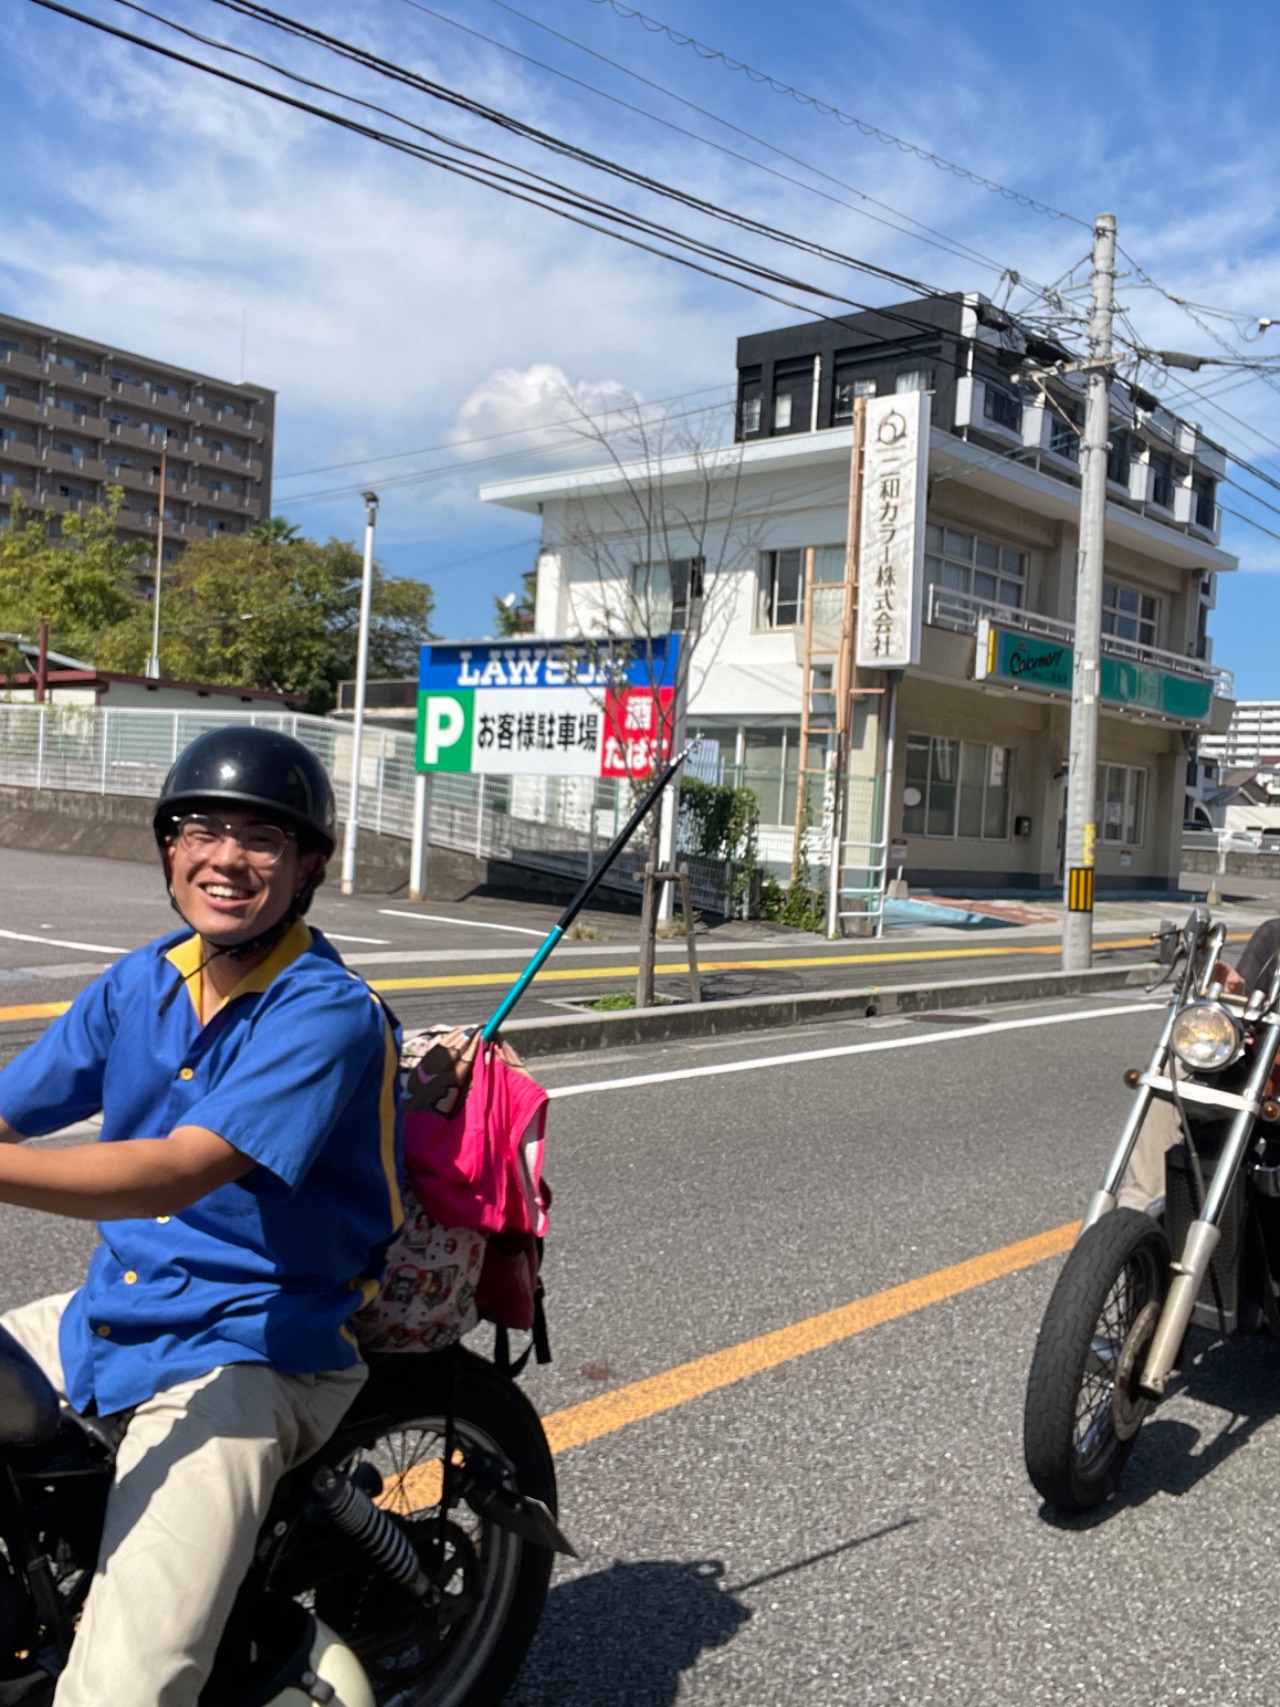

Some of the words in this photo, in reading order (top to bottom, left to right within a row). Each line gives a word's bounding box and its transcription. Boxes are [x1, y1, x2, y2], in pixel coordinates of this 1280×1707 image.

[424, 696, 465, 764] P
[478, 712, 598, 751] お客様駐車場
[625, 696, 653, 730] 酒
